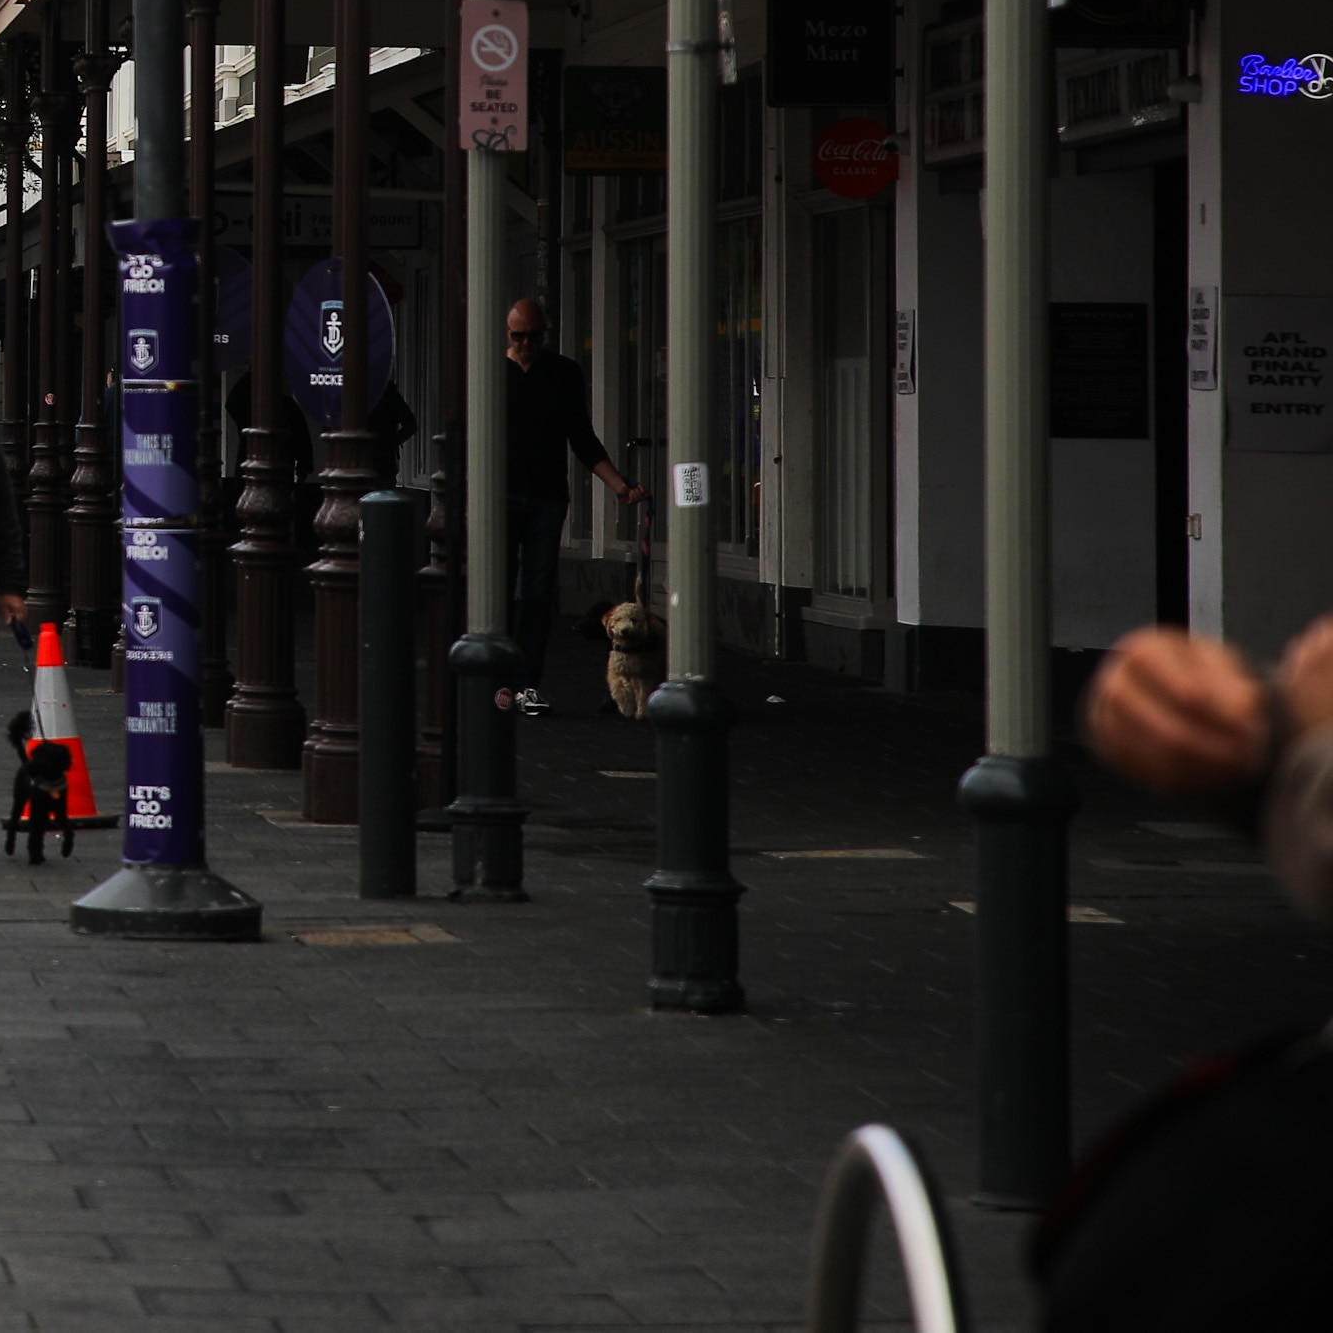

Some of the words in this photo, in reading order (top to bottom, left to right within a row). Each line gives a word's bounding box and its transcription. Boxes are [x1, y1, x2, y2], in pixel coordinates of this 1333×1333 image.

[804, 19, 869, 39] Mezo
[805, 43, 861, 62] Mart
[1240, 52, 1316, 82] Barber
[1238, 76, 1299, 97] SHOP
[486, 90, 502, 99] BE
[470, 102, 518, 114] SEATED
[833, 166, 878, 176] CLASSIC
[370, 215, 413, 226] OGURT
[129, 265, 154, 279] GO
[1262, 332, 1309, 344] AFL
[1244, 346, 1327, 358] GRAND
[1251, 361, 1321, 372] FINAL
[309, 372, 344, 386] DOCKE
[1247, 375, 1324, 387] PARTY
[1250, 402, 1326, 415] ENTRY
[132, 531, 157, 546] GO
[138, 701, 163, 717] THIS
[129, 785, 171, 801] LET'S
[135, 800, 161, 815] GO
[129, 814, 173, 829] FREO!
